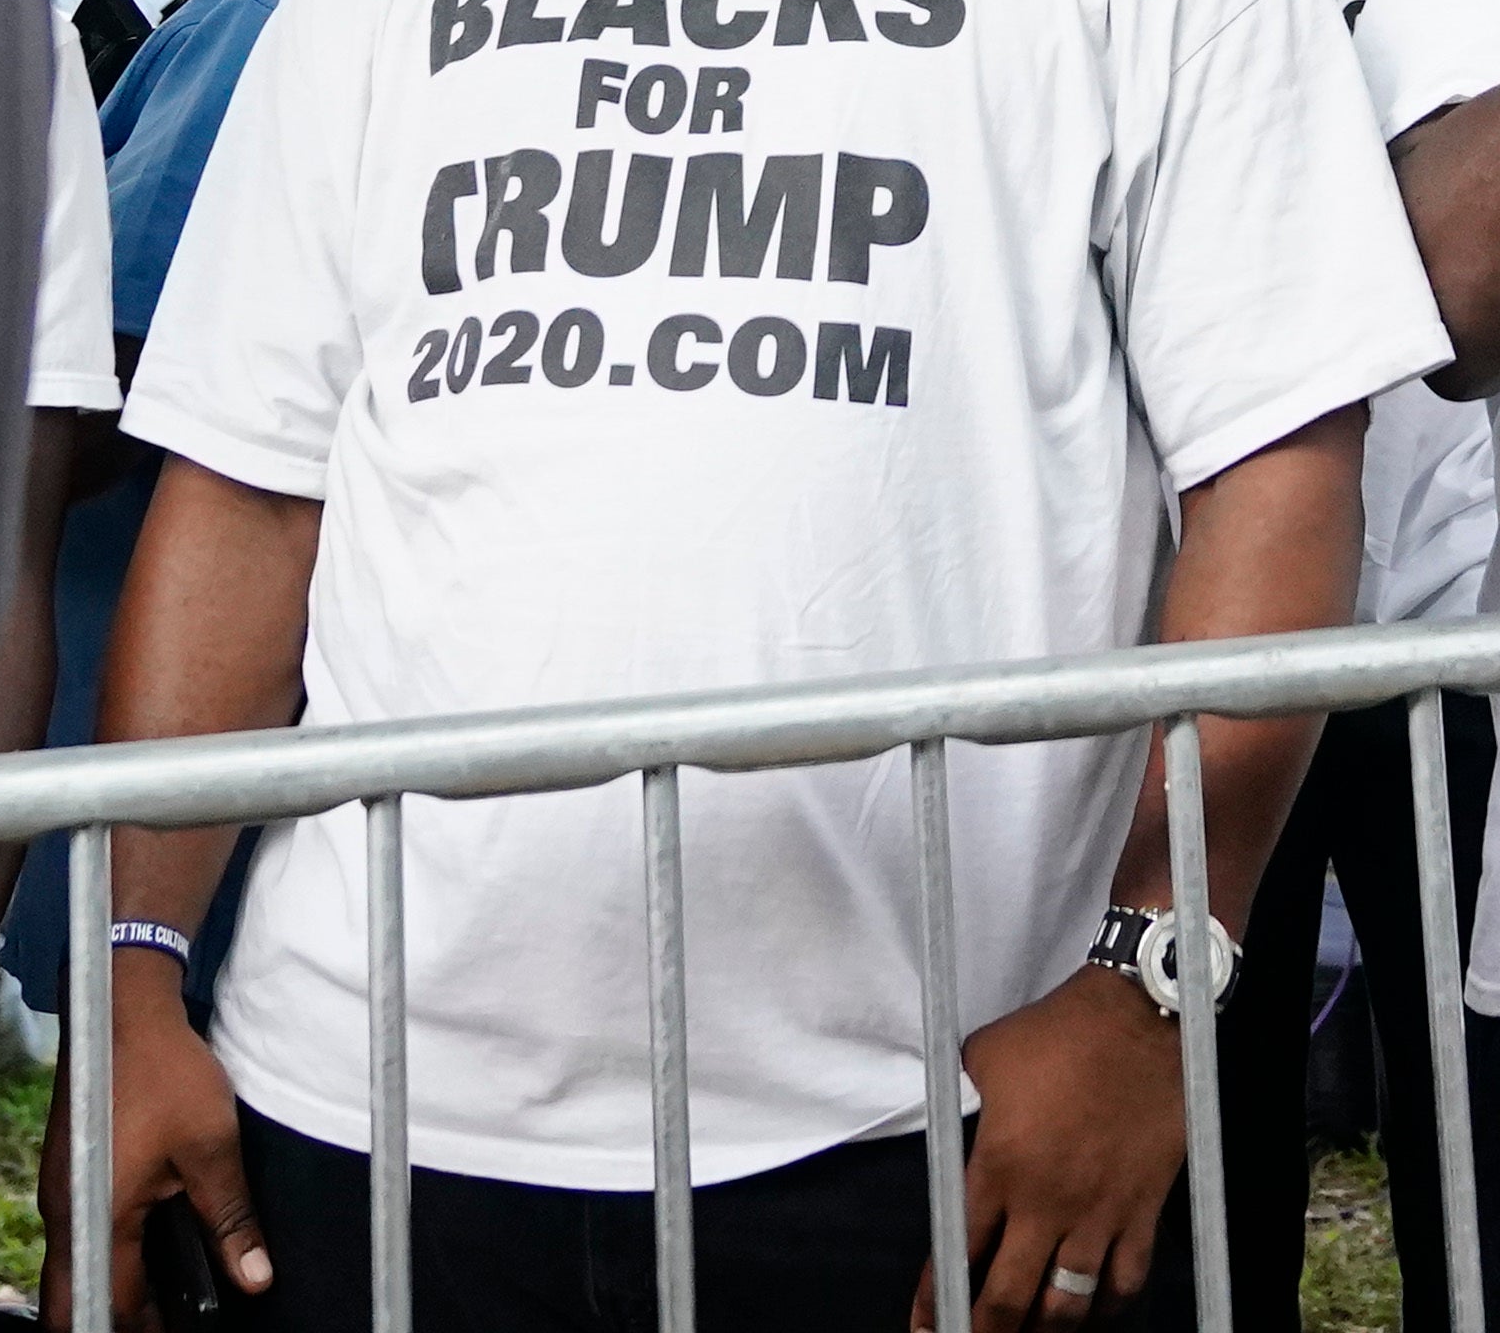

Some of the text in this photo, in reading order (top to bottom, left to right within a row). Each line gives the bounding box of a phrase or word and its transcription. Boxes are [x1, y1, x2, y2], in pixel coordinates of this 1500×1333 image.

[575, 58, 751, 135] FOR
[421, 148, 929, 295] TRUMP
[407, 307, 912, 407] 2020.COM
[128, 922, 156, 942] THE
